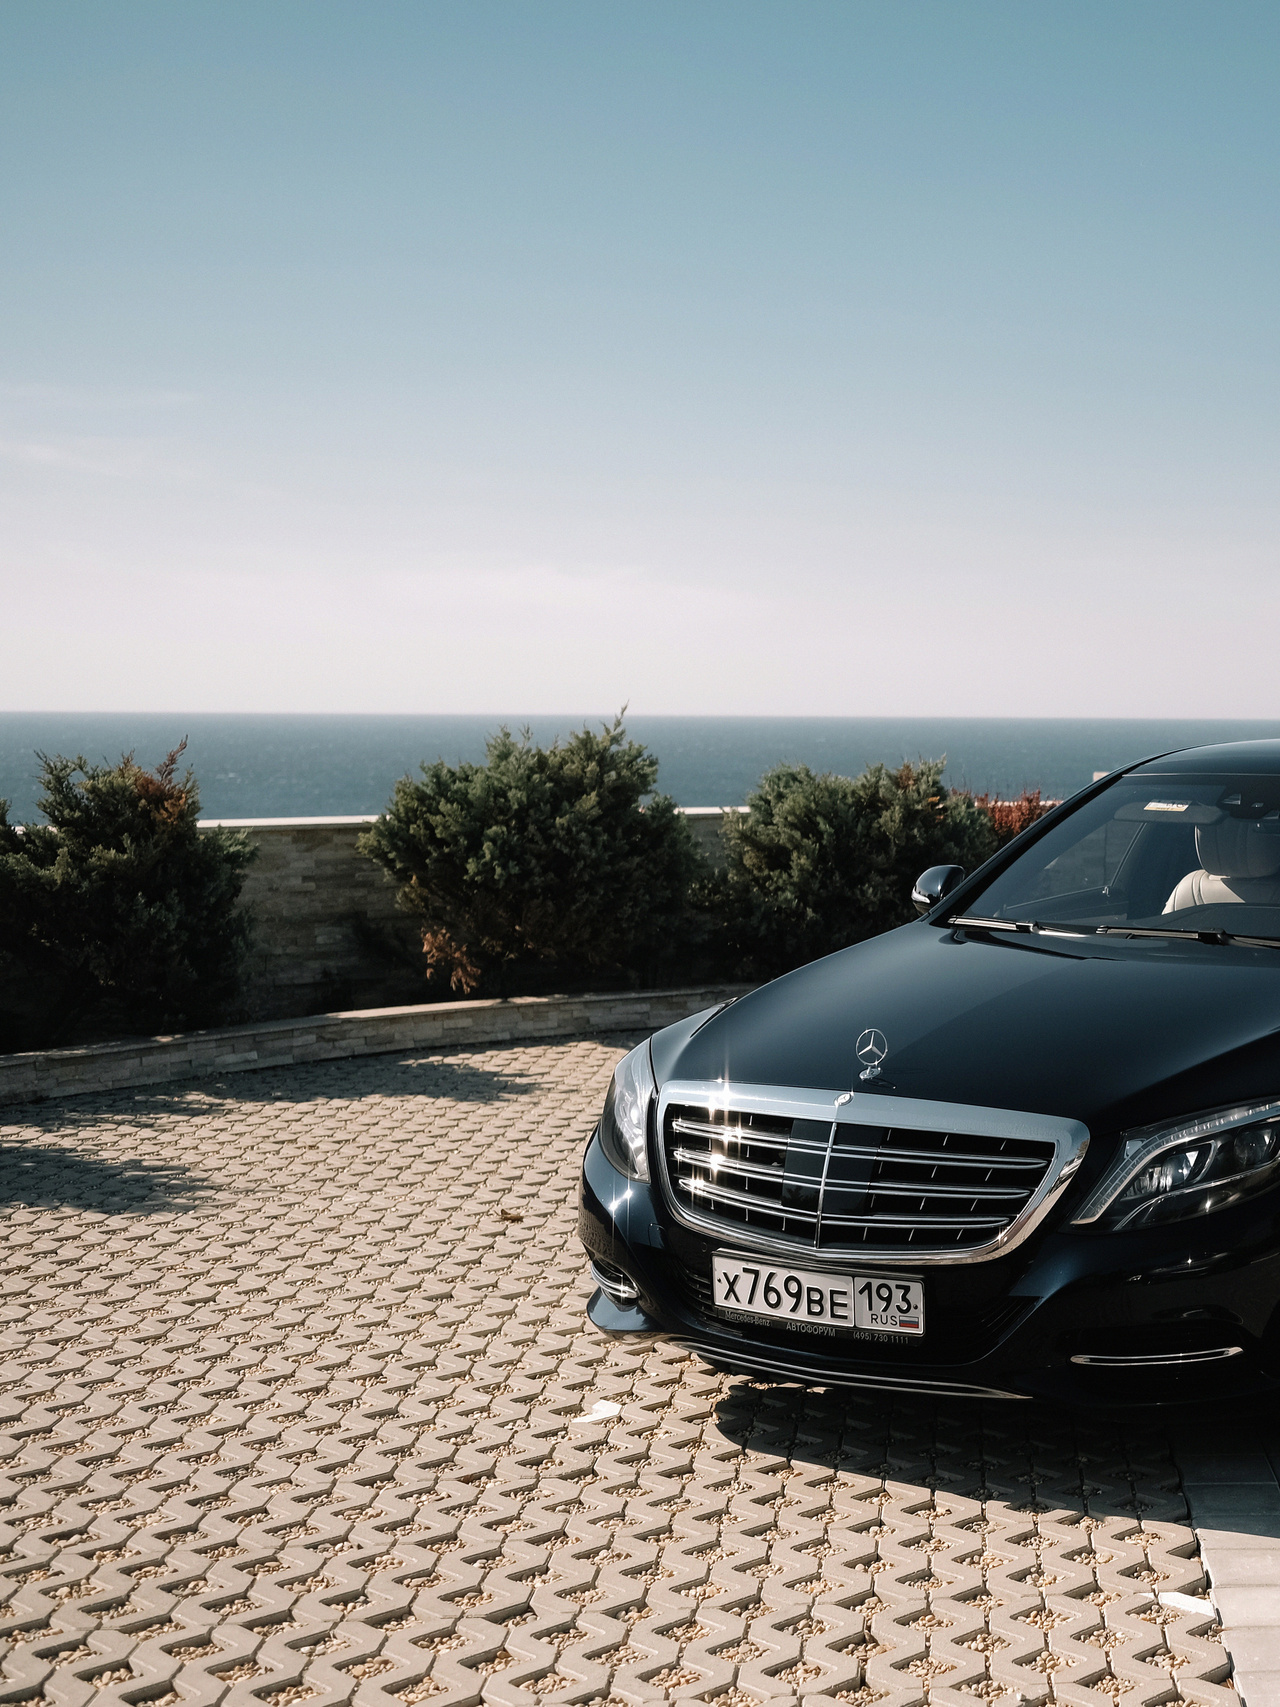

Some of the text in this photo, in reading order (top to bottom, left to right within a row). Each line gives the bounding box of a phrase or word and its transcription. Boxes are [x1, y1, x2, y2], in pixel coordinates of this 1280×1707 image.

[858, 1281, 912, 1314] 193
[725, 1310, 772, 1327] Mercedes-Benz
[870, 1314, 898, 1326] RUS
[786, 1323, 836, 1337] АВТОФОРУМ
[853, 1331, 872, 1341] (495)
[873, 1333, 889, 1342] 730
